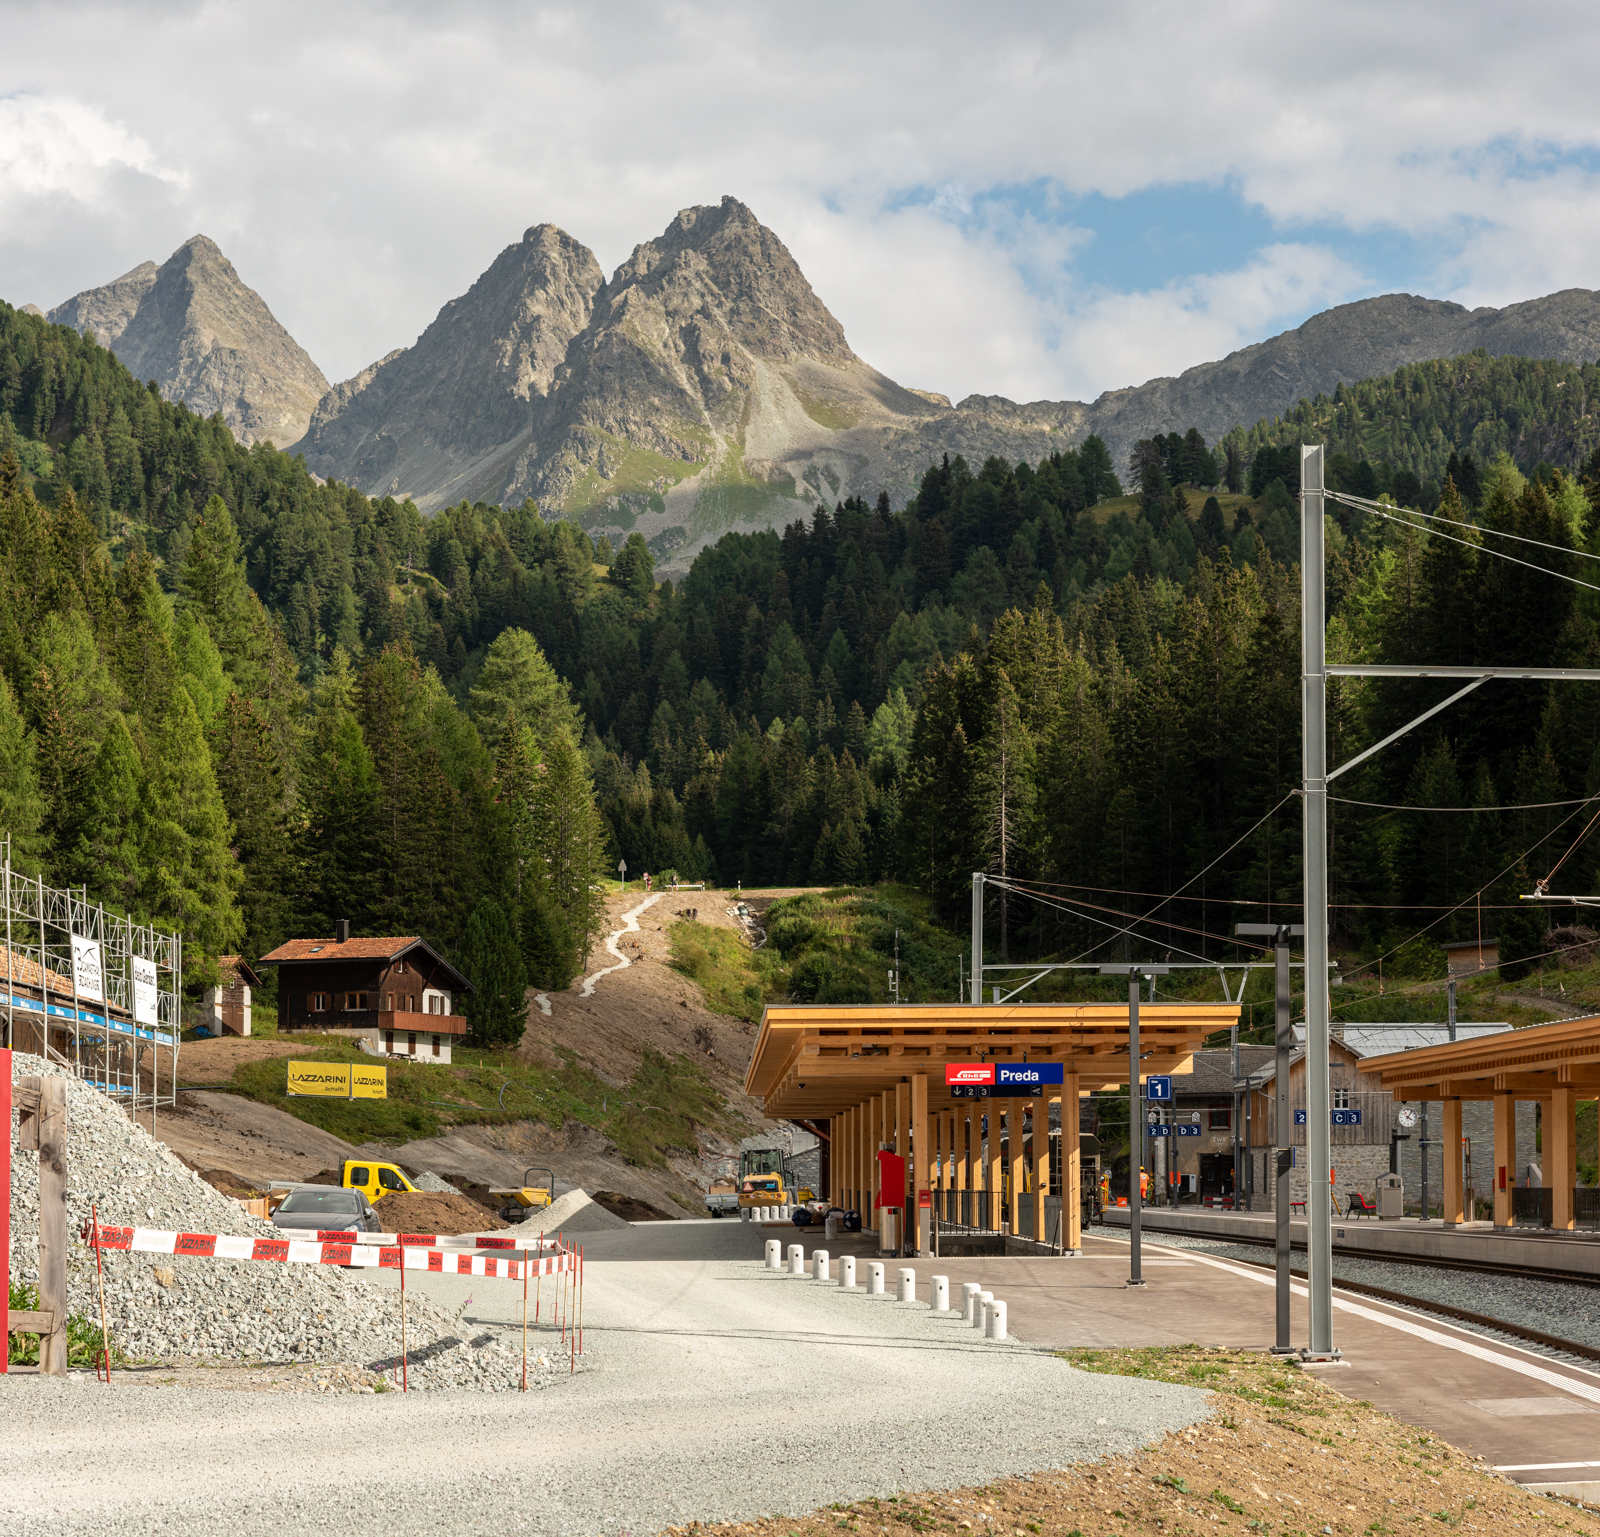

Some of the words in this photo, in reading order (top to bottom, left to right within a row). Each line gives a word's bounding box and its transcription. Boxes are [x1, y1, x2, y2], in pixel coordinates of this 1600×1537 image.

[292, 1073, 346, 1084] LAZZARINI
[1000, 1069, 1039, 1082] Preda
[354, 1076, 385, 1087] LAZZARINI
[968, 1088, 974, 1096] 2
[981, 1088, 987, 1096] 3
[1155, 1084, 1162, 1097] 1
[1299, 1114, 1305, 1123] 2
[1335, 1114, 1343, 1123] C
[1350, 1114, 1357, 1123] 3
[1180, 1127, 1187, 1135] D
[1192, 1127, 1198, 1135] 3
[317, 1232, 357, 1241] LAZZARINI
[476, 1239, 516, 1248] LAZZARINI
